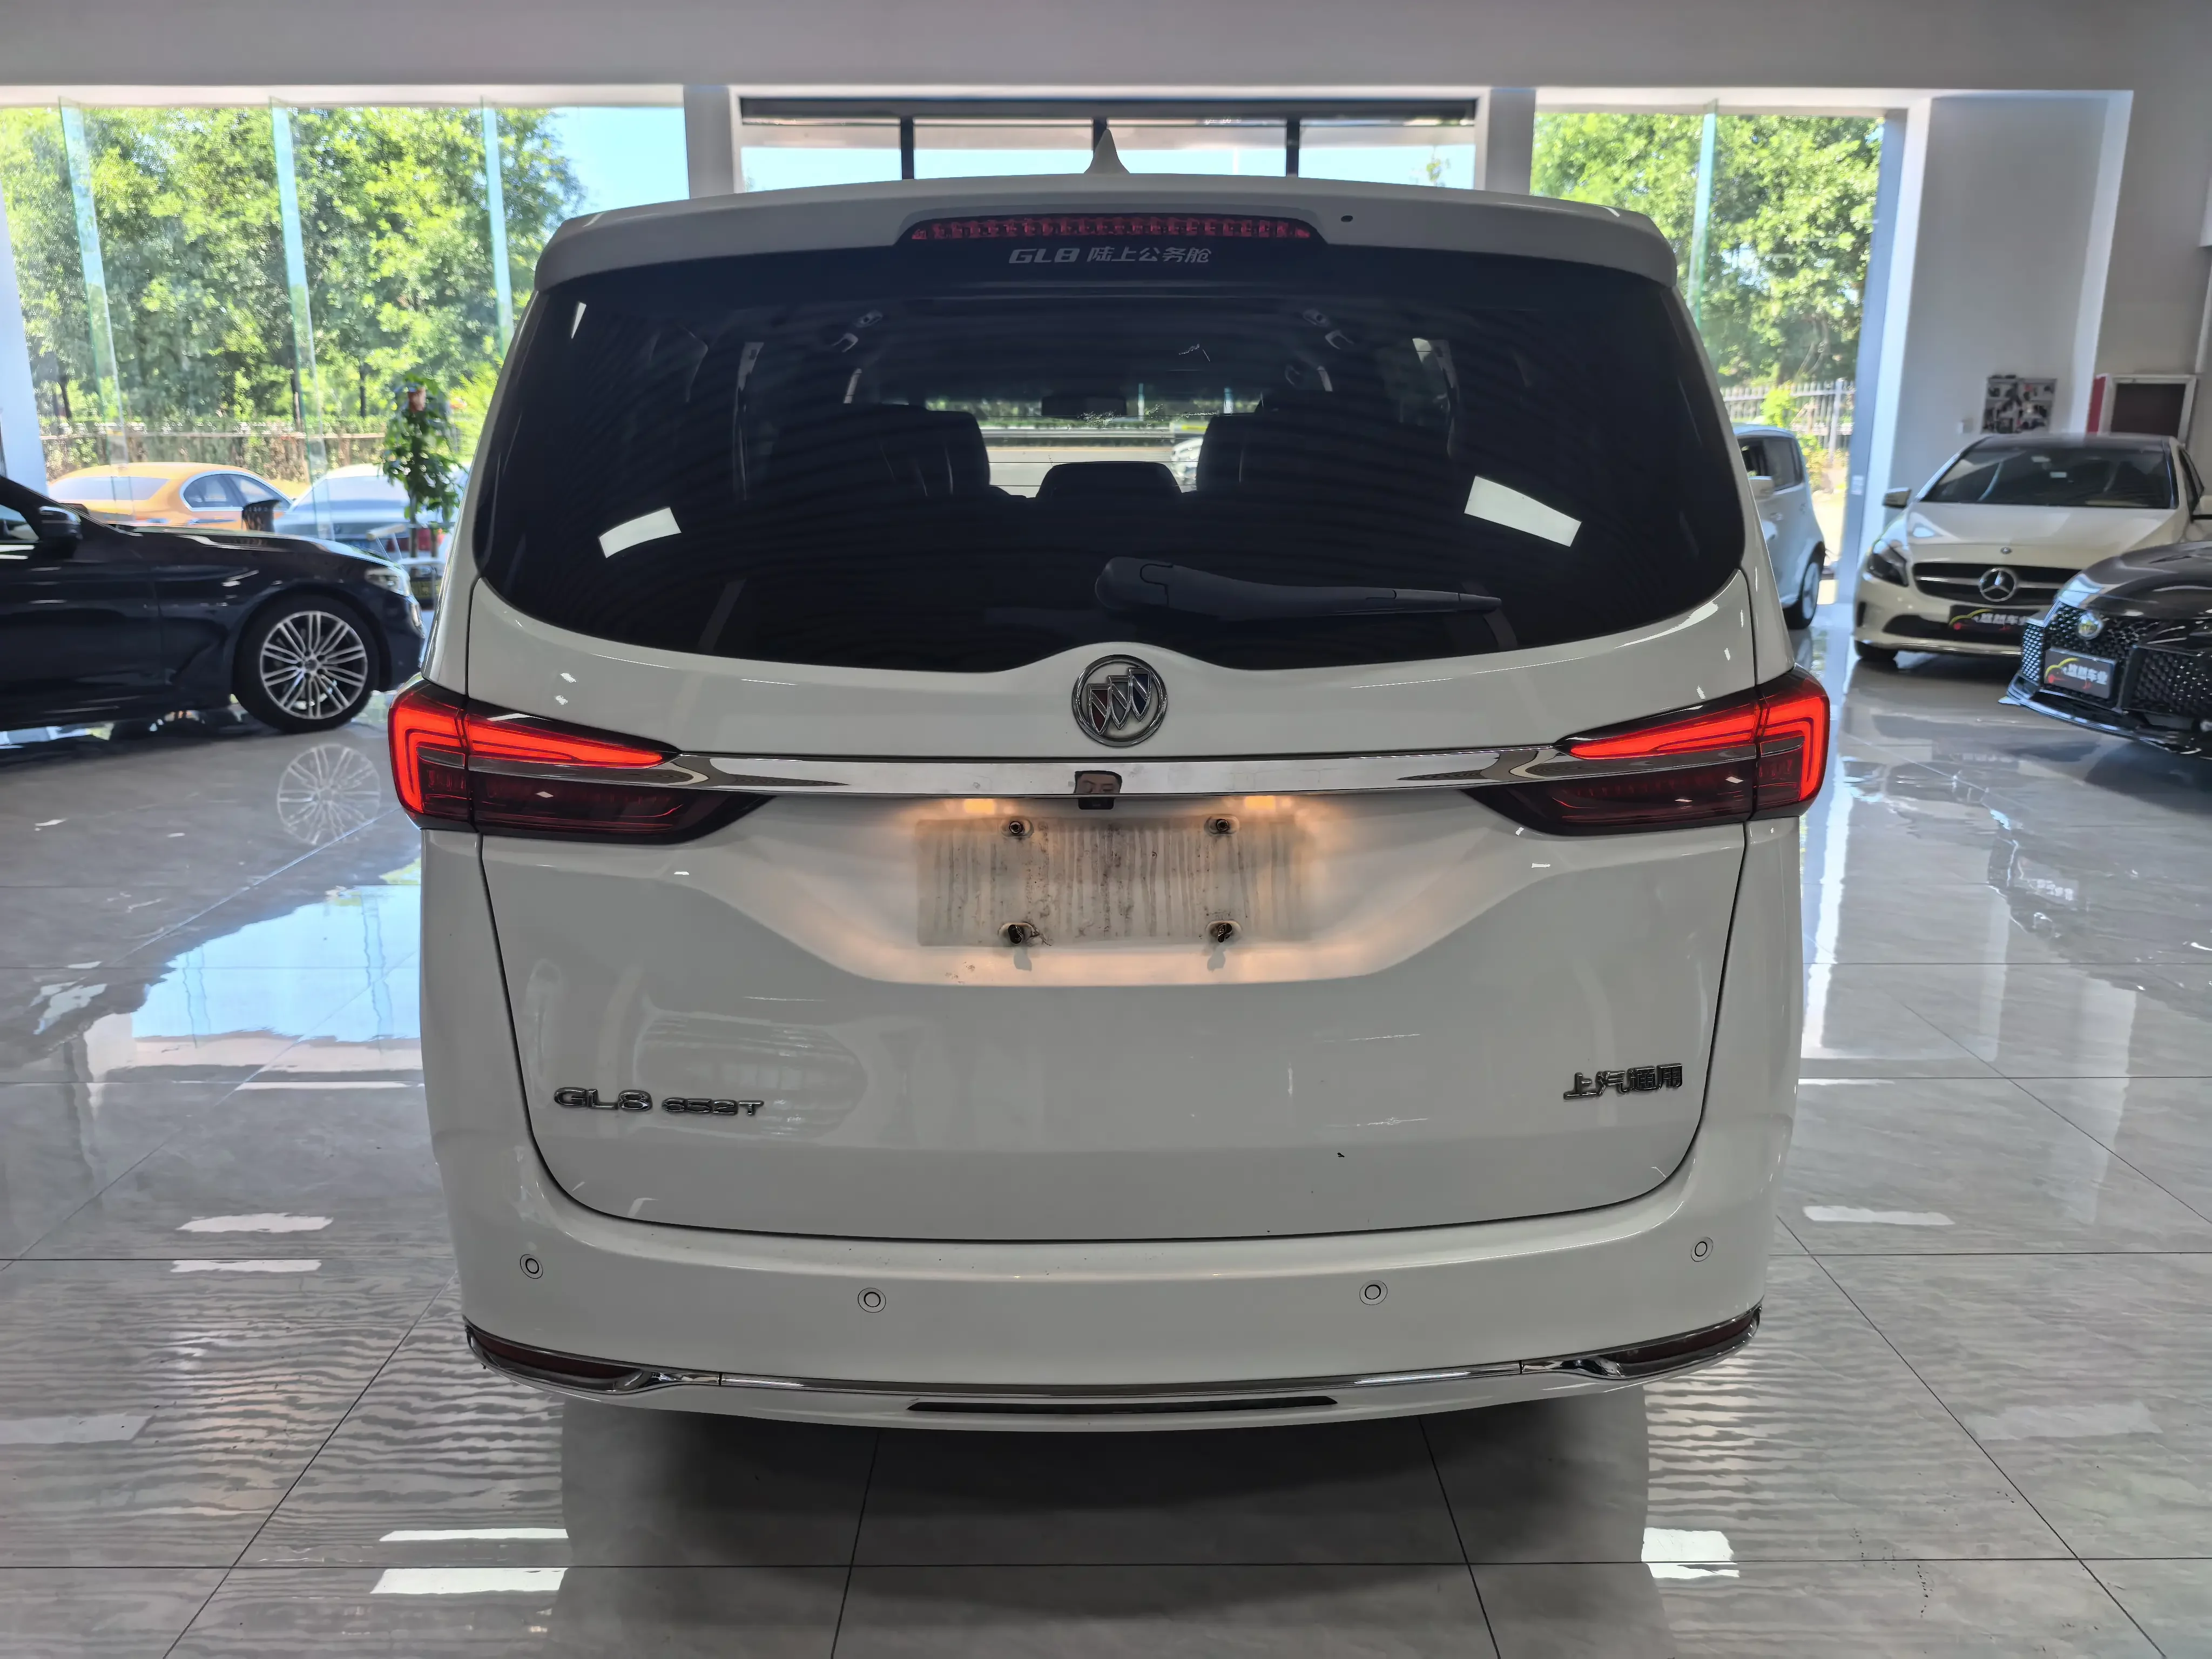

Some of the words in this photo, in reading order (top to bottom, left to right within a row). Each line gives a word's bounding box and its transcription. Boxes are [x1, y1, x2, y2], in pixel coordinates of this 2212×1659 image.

[1008, 248, 1080, 264] GL8
[1087, 246, 1212, 263] 陆上公务舱
[1563, 1063, 1683, 1100] 上汽通用
[553, 1087, 652, 1111] GL8
